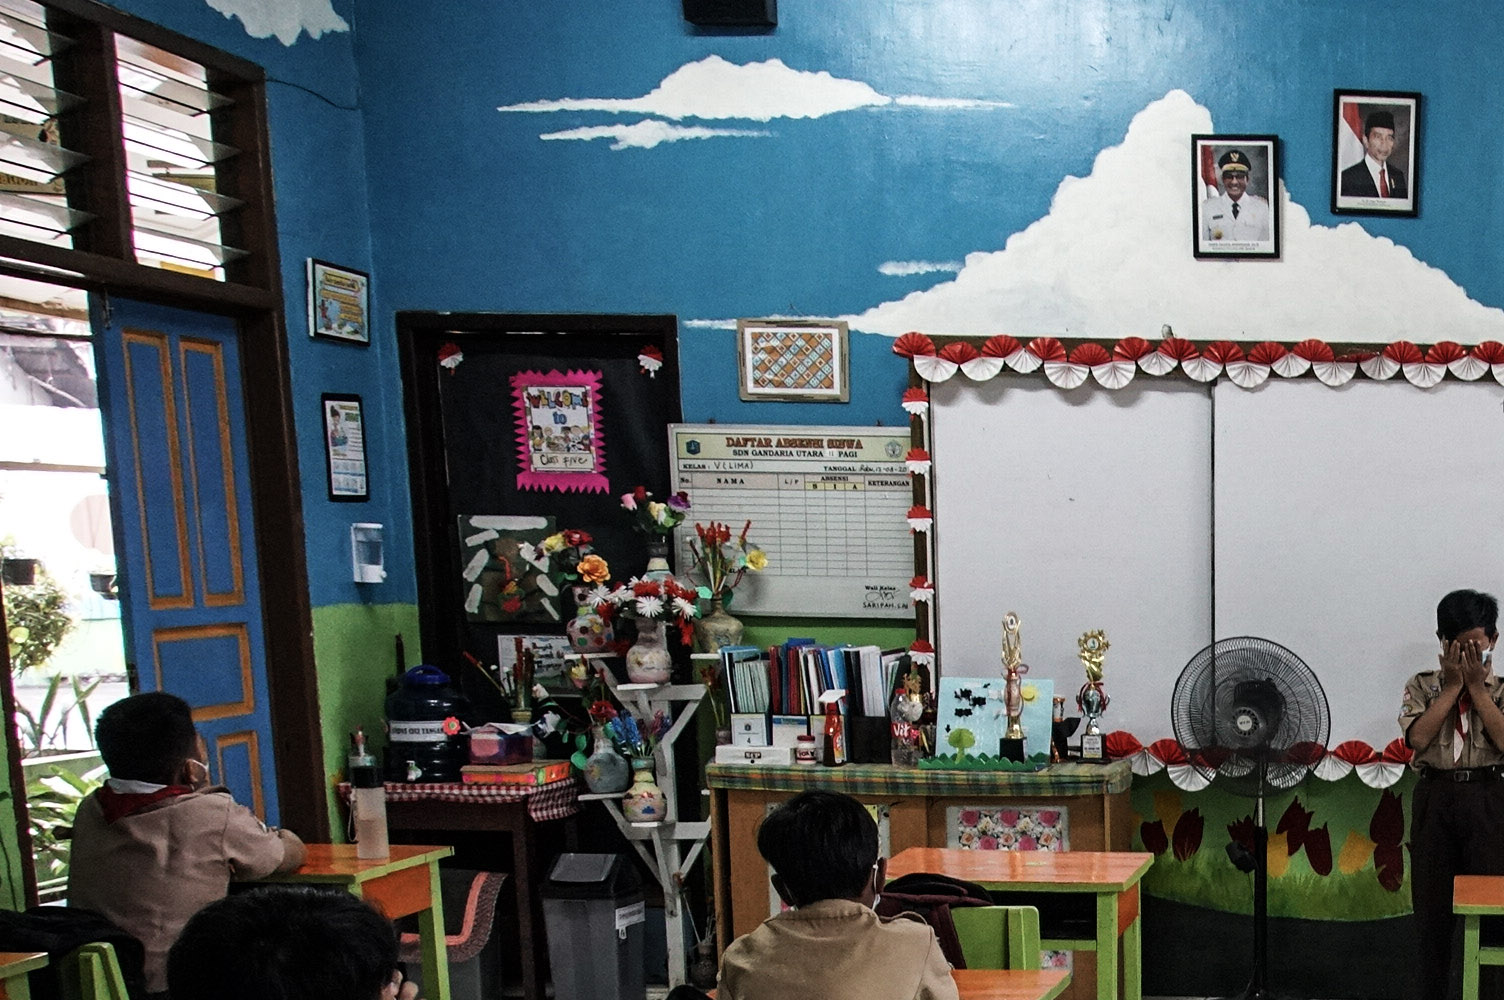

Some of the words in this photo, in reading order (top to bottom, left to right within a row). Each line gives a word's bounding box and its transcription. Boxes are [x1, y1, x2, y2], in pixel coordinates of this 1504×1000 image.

[725, 436, 773, 448] DAFTAR
[775, 437, 824, 449] ABSENSI
[826, 438, 864, 450] SISWA
[732, 449, 749, 457] SDN
[751, 449, 794, 457] GANDARIA
[796, 450, 824, 458] UTARA
[838, 450, 858, 458] PAGI
